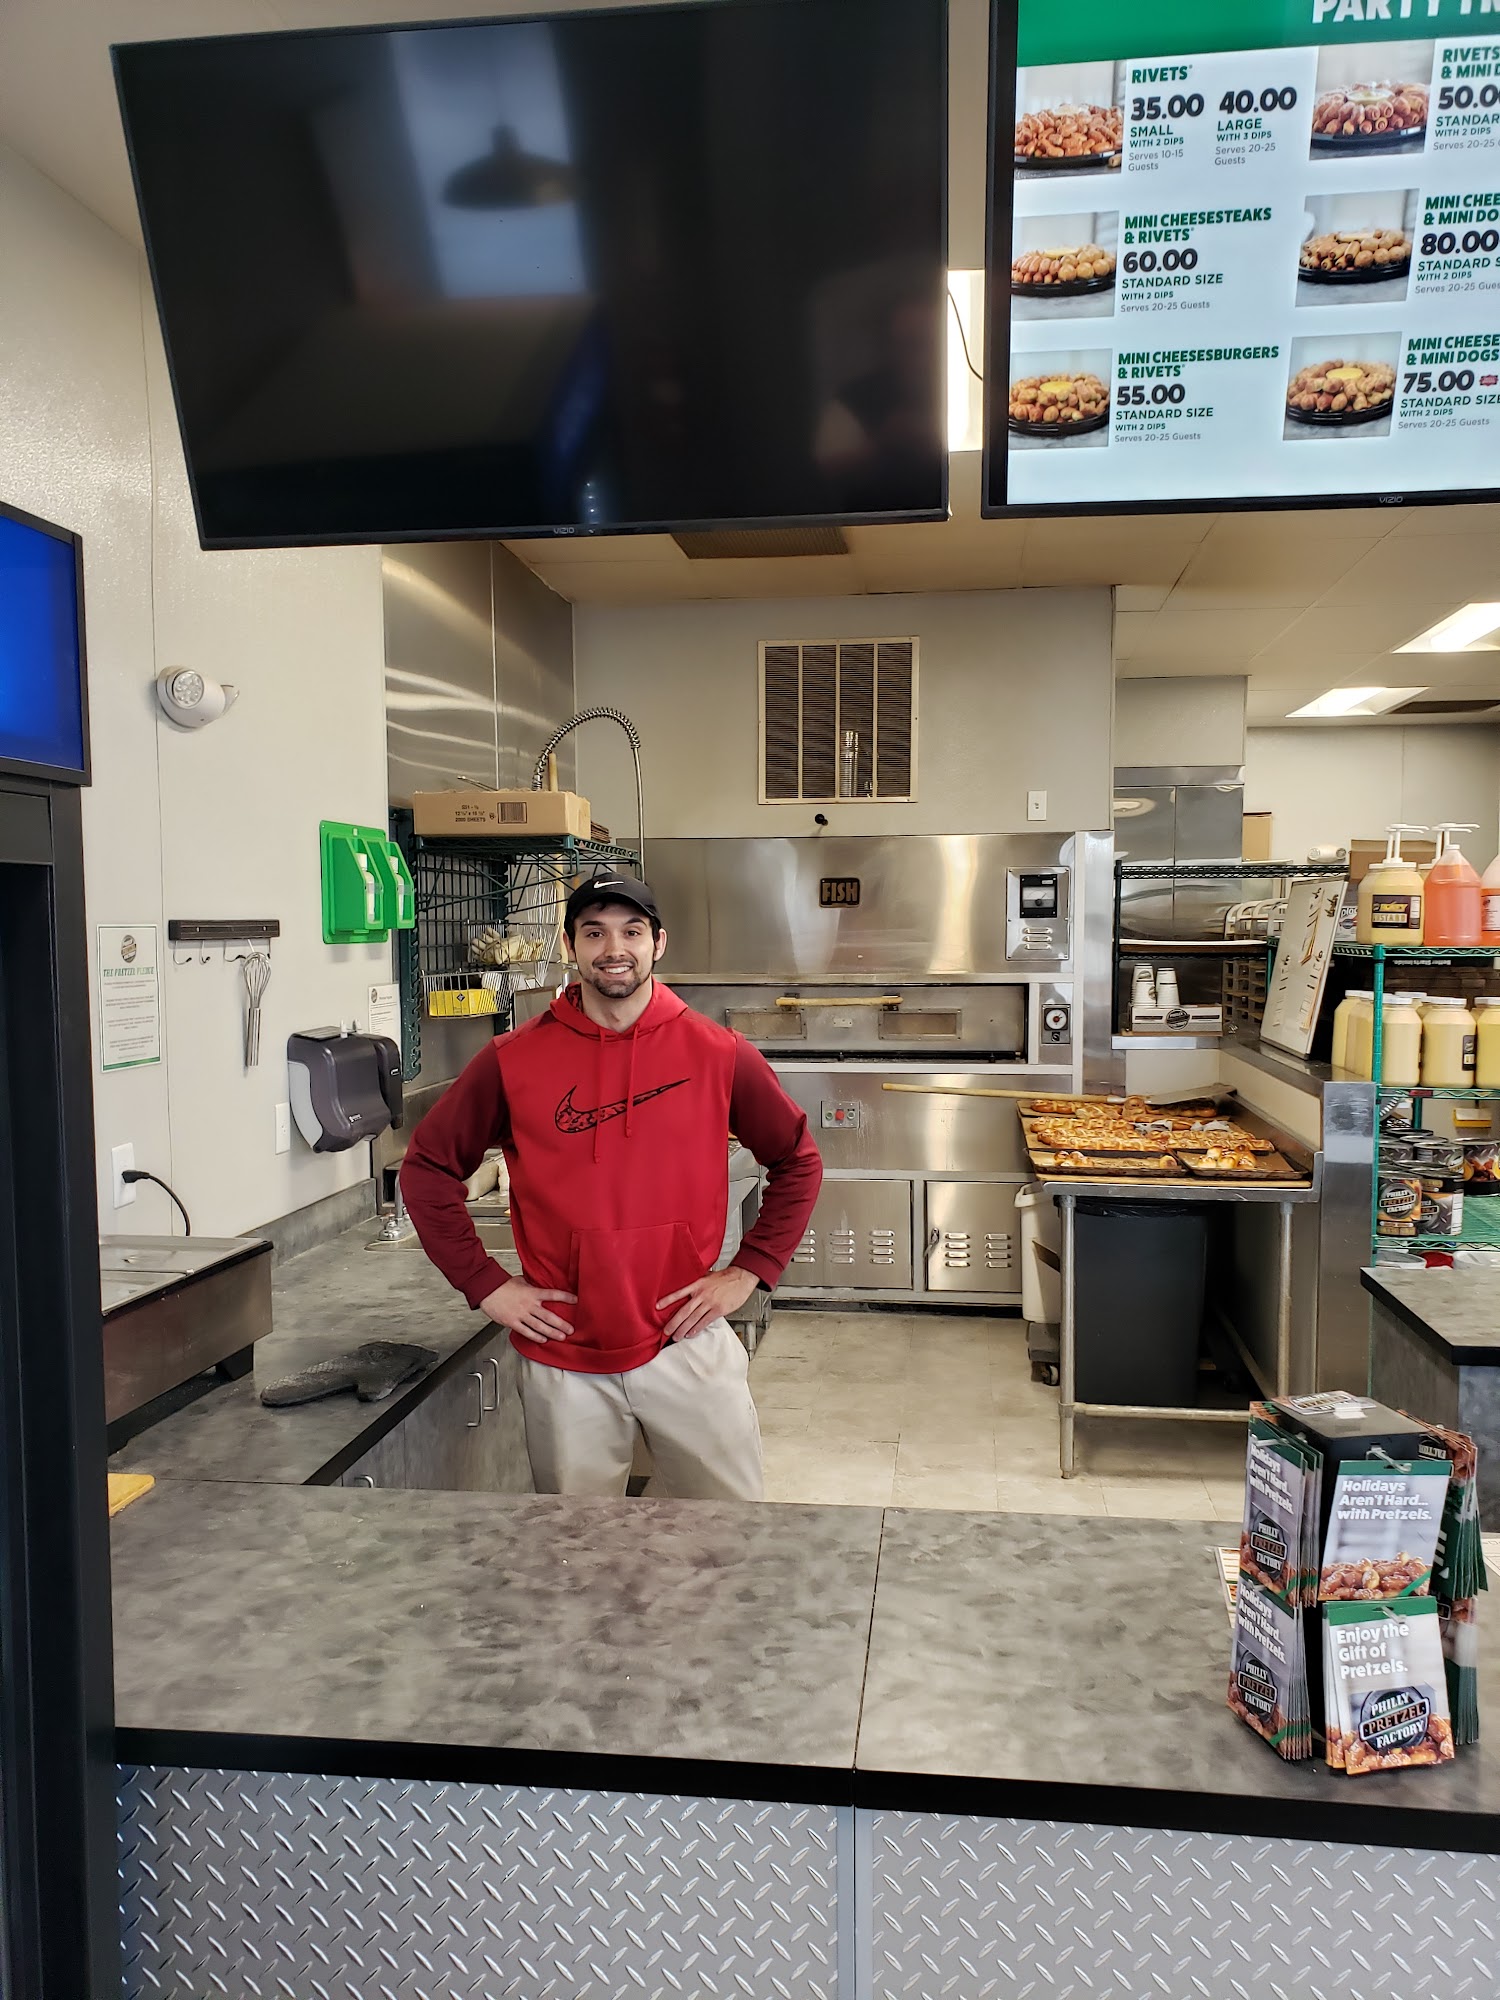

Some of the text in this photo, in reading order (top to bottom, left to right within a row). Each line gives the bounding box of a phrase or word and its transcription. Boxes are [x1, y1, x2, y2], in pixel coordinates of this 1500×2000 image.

[1131, 65, 1188, 84] RIVETS
[1441, 66, 1452, 79] &
[1456, 64, 1491, 78] MINI
[1219, 86, 1297, 114] 40.00
[1438, 84, 1500, 110] 50.0
[1131, 93, 1205, 121] 35.00
[1130, 124, 1174, 138] SMALL
[1217, 118, 1262, 132] LARGE
[1435, 126, 1491, 137] WITH 2 DIPS
[1130, 136, 1184, 148] WITH 2 DIPS
[1216, 131, 1272, 142] WITH 3 DIPS
[1215, 143, 1276, 155] Serves 20-25
[1433, 141, 1464, 151] Serves
[1467, 138, 1494, 149] 20-25
[1128, 149, 1184, 161] Serves 10-15
[1214, 156, 1246, 166] Guests
[1128, 163, 1159, 172] Guests
[1425, 195, 1460, 210] MINI
[1125, 207, 1272, 229] MINI CHEESESTEAKS
[1423, 212, 1434, 225] &
[1438, 210, 1473, 224] MINI
[1124, 228, 1190, 244] & RIVETS
[1420, 229, 1500, 256] 80.00
[1123, 248, 1198, 273] 60.00
[1417, 258, 1491, 272] STANDARD
[1122, 273, 1224, 289] STANDARD SIZE
[1417, 271, 1472, 281] WITH 2 DIPS
[1121, 292, 1144, 300] WITH
[1154, 291, 1174, 299] DIPS
[1415, 285, 1445, 294] Serves
[1448, 282, 1475, 292] 20-25
[1120, 301, 1210, 313] Serves 20-25 Guests
[1408, 337, 1442, 351] MINI
[1118, 352, 1150, 365] MINI
[1406, 349, 1499, 366] & MINI DOGS
[1118, 365, 1181, 379] & RIVETS
[1402, 369, 1475, 394] 75.00
[1116, 383, 1186, 406] 55.00
[1401, 395, 1471, 408] STANDARD
[1116, 407, 1214, 420] STANDARD SIZE
[1433, 408, 1453, 416] DIPS
[1398, 418, 1490, 429] Serves 20-25 Guests
[1144, 433, 1170, 442] 20-25
[1172, 432, 1201, 441] Guests
[822, 882, 858, 902] FISH
[1342, 1479, 1406, 1494] Holidays
[1339, 1494, 1428, 1506] Aren't Hard...
[1337, 1508, 1432, 1520] with Pretzels.
[1258, 1522, 1279, 1539] PHILLY
[1254, 1535, 1284, 1557] PRETZEL
[1240, 1583, 1272, 1619] Holidays
[1239, 1599, 1260, 1625] Aren't
[1238, 1614, 1255, 1637] with
[1336, 1623, 1409, 1645] Enjoy the
[1339, 1642, 1387, 1662] Gift of
[1245, 1662, 1268, 1681] PHILLY
[1340, 1658, 1409, 1680] Pretzels.
[1241, 1675, 1273, 1699] PRETZEL
[1245, 1691, 1272, 1714] FACTORY
[1371, 1691, 1410, 1716] PHILLY
[1368, 1704, 1424, 1735] PRETZEL
[1376, 1720, 1425, 1749] FACTORY
